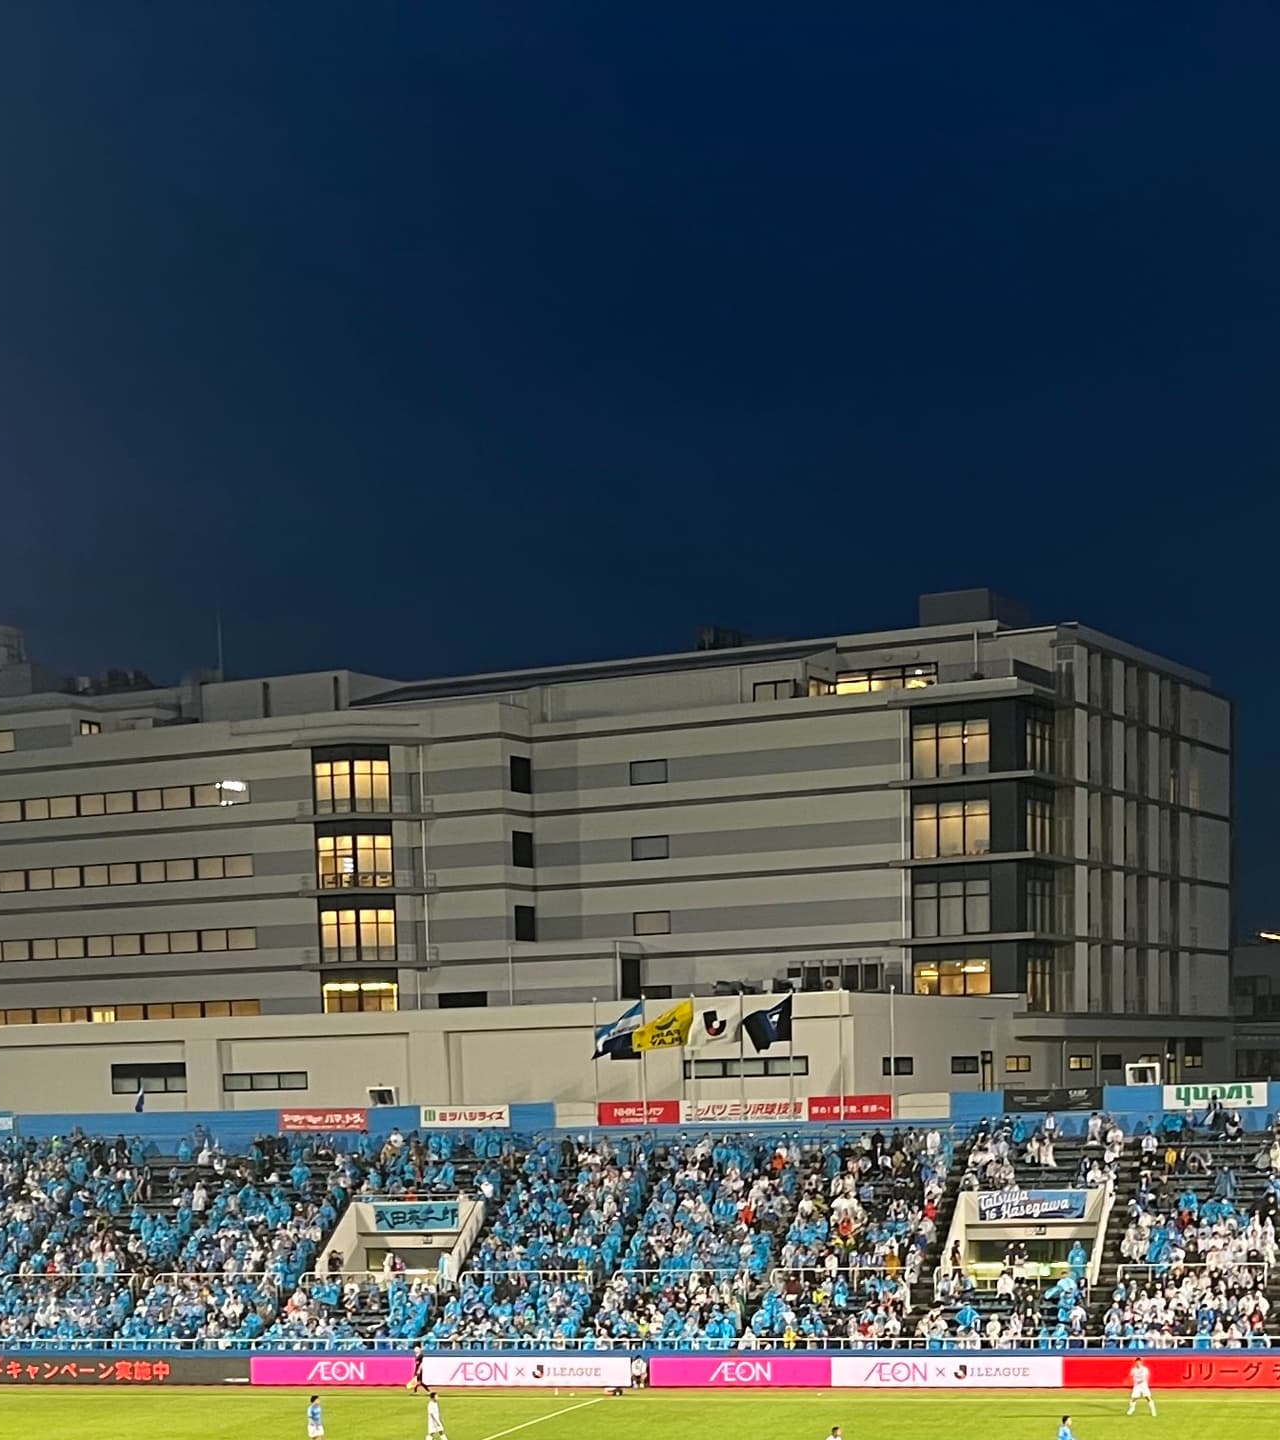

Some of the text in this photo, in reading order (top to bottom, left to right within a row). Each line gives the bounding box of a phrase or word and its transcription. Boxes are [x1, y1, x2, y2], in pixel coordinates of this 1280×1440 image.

[438, 1110, 505, 1122] ミツハシライス
[979, 1190, 1029, 1210] Tatsuya
[1000, 1199, 1070, 1219] Hasegawa
